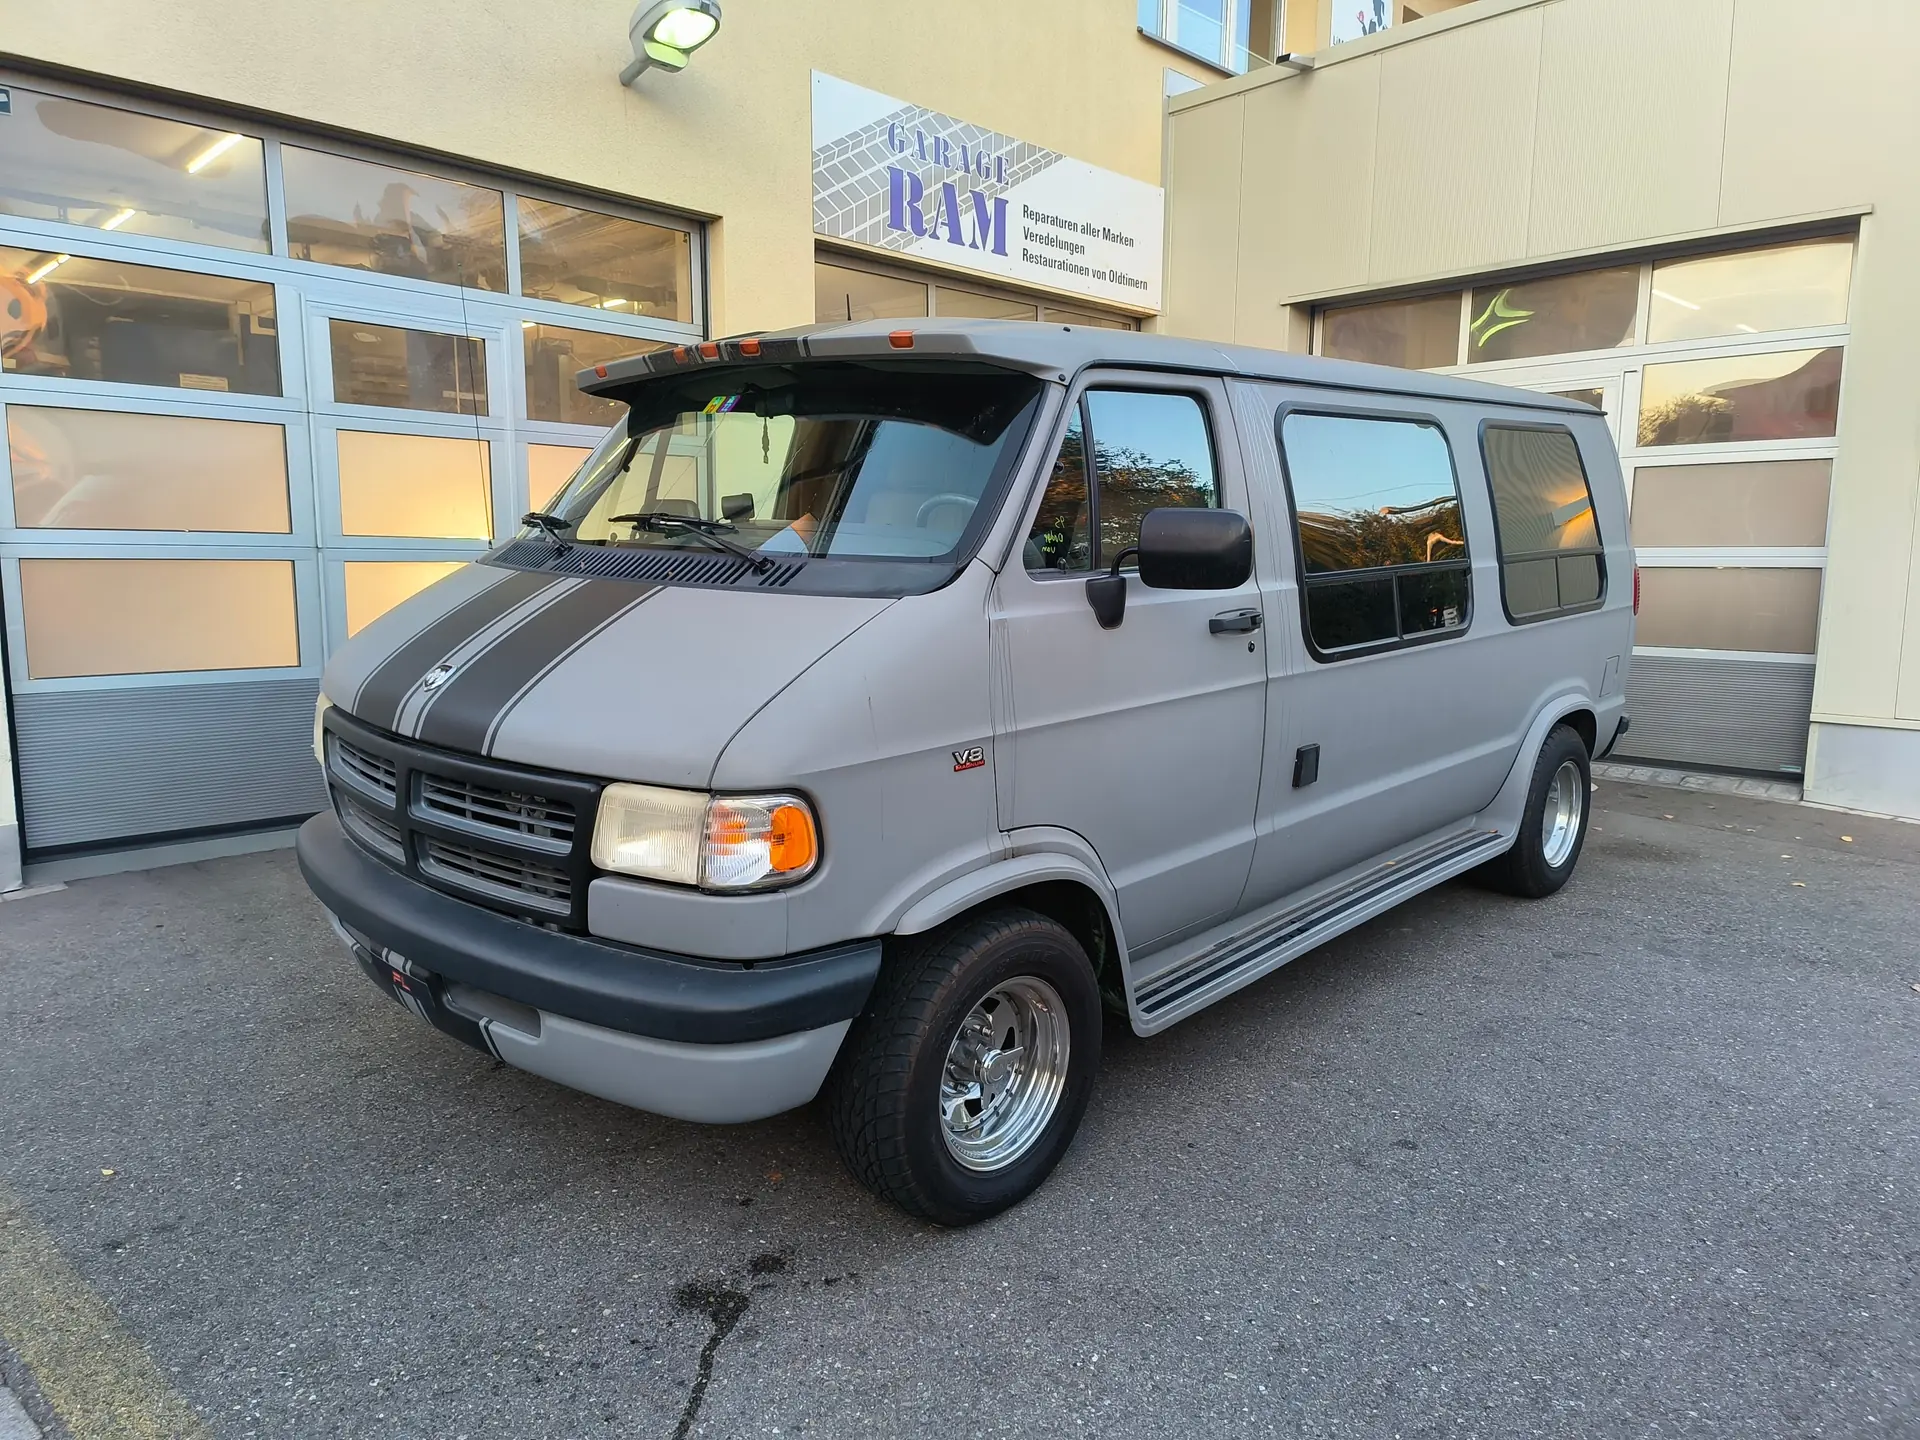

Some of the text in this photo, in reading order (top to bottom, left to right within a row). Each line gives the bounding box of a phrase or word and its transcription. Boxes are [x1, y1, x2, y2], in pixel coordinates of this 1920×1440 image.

[888, 122, 1009, 185] GARAGE
[887, 165, 1008, 257] RAM
[1023, 204, 1134, 247] Reparaturen aller Marken
[1023, 226, 1085, 255] Veredelungen
[1022, 248, 1148, 290] Restaurationen von Oldtimern
[953, 746, 983, 765] V8
[392, 971, 411, 992] FL
